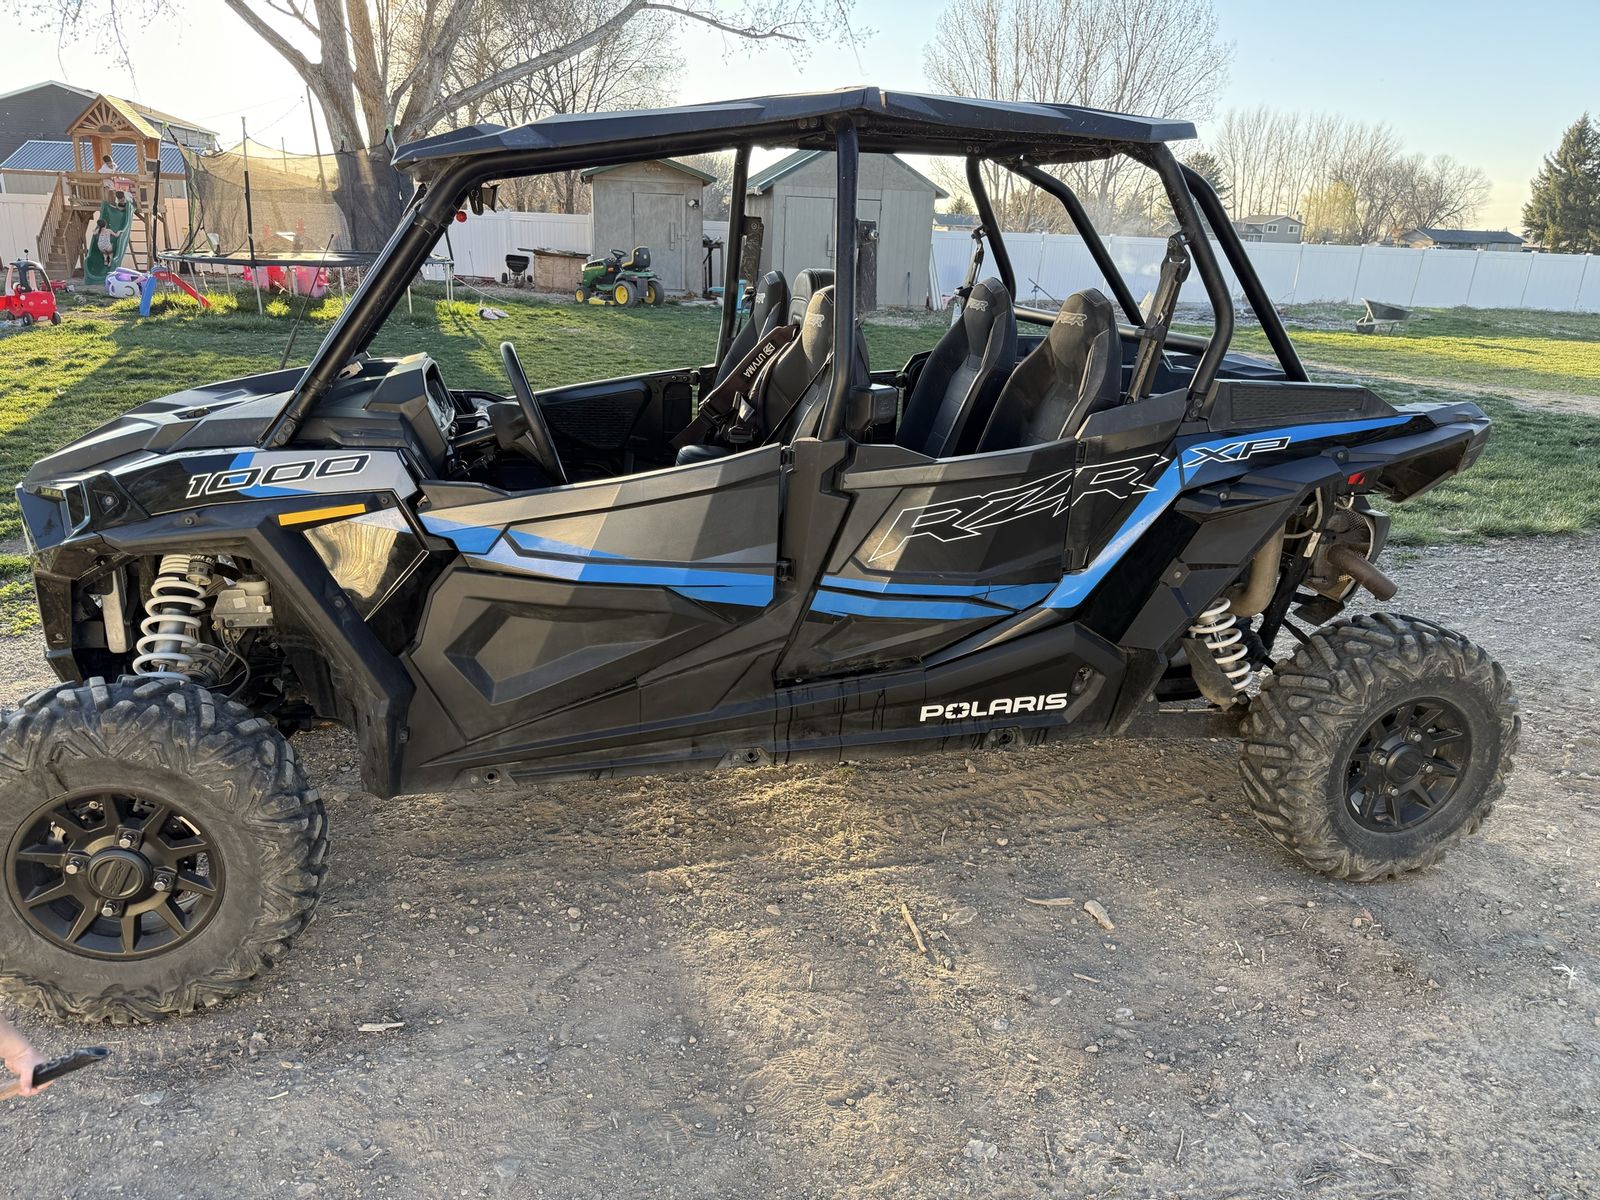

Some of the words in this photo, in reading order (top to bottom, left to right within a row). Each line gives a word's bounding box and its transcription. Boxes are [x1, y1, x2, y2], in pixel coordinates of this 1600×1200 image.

[1056, 311, 1088, 327] RZR
[743, 353, 768, 378] UTVMA
[1175, 436, 1291, 470] XP
[185, 453, 372, 499] 1000
[868, 453, 1170, 562] RZR
[919, 692, 1068, 722] POLARIS
